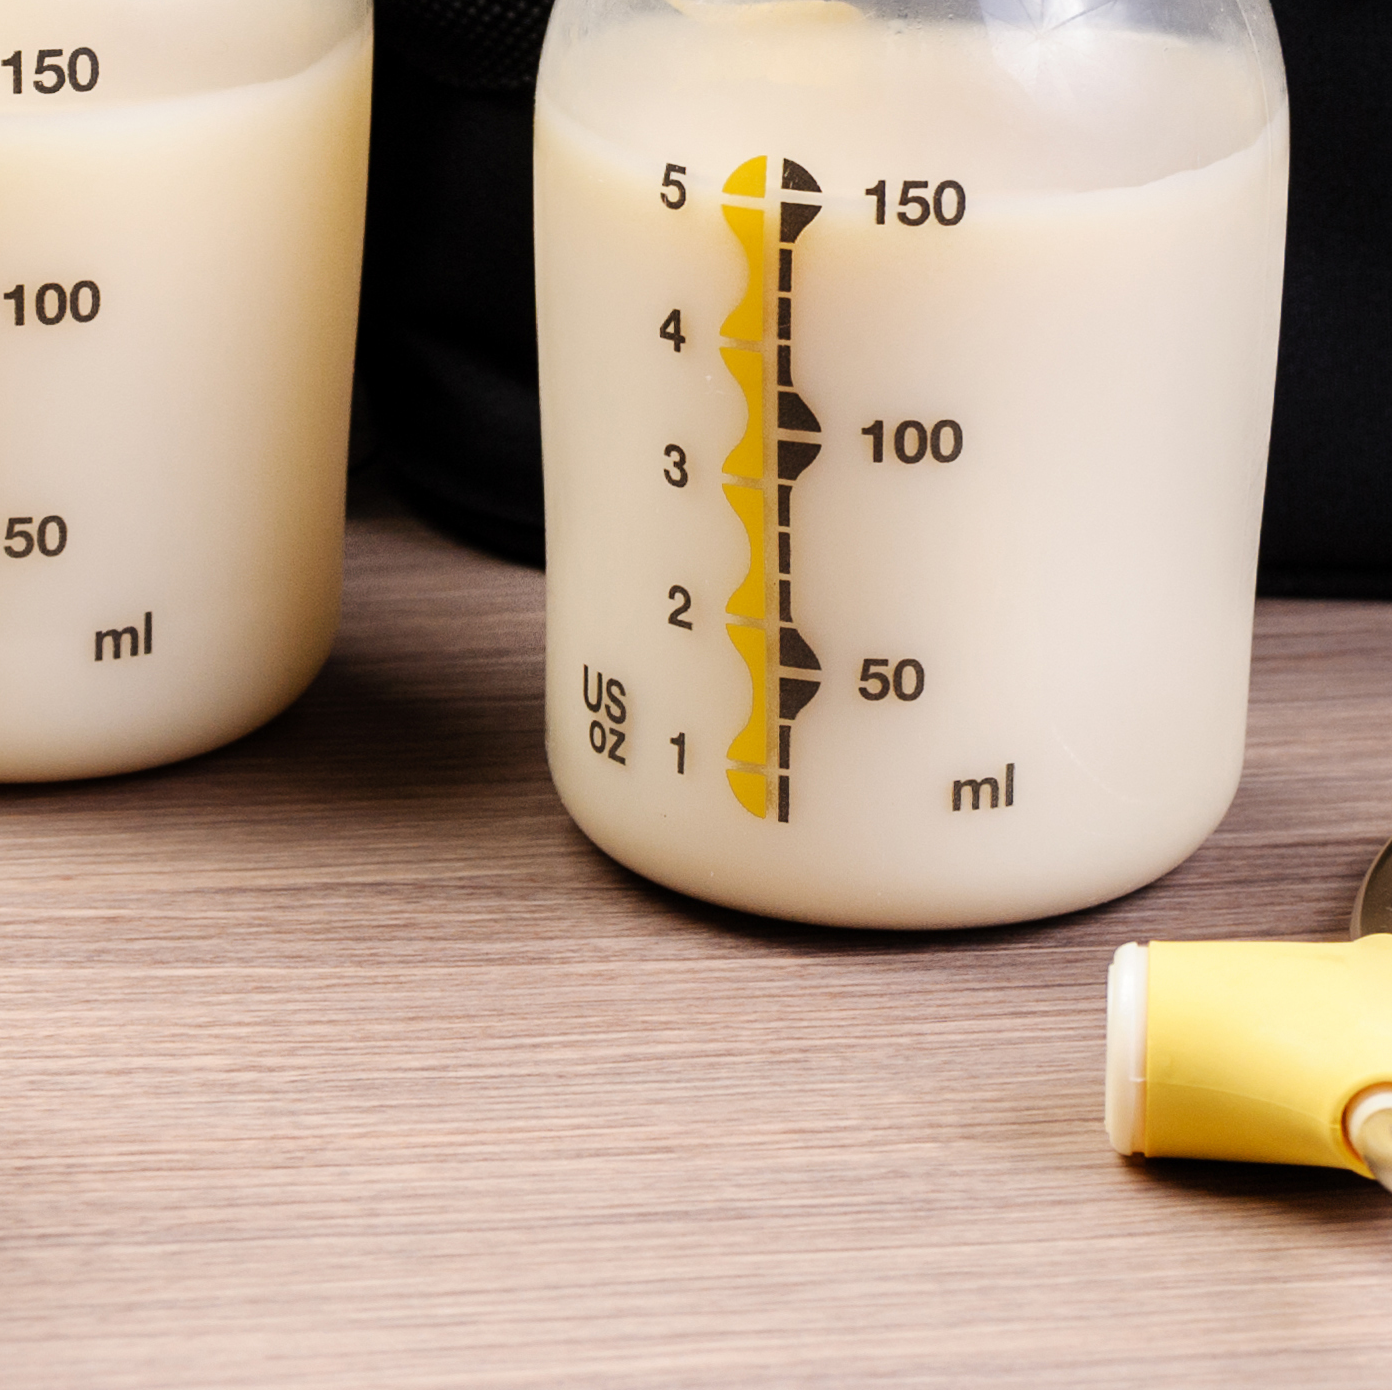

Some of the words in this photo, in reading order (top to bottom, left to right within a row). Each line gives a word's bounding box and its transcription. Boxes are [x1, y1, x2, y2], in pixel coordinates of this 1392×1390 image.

[1, 47, 100, 94] 150
[660, 164, 687, 210] 5
[865, 180, 966, 226] 150
[3, 280, 101, 326] 100
[660, 309, 686, 352] 4
[861, 419, 963, 464] 100
[663, 444, 688, 488] 3
[4, 515, 68, 559] 50
[668, 585, 693, 630] 2
[94, 612, 153, 662] ml
[583, 665, 627, 725] US
[858, 658, 925, 701] 50
[589, 720, 627, 766] oz
[669, 732, 686, 774] 1
[951, 763, 1015, 812] ml
